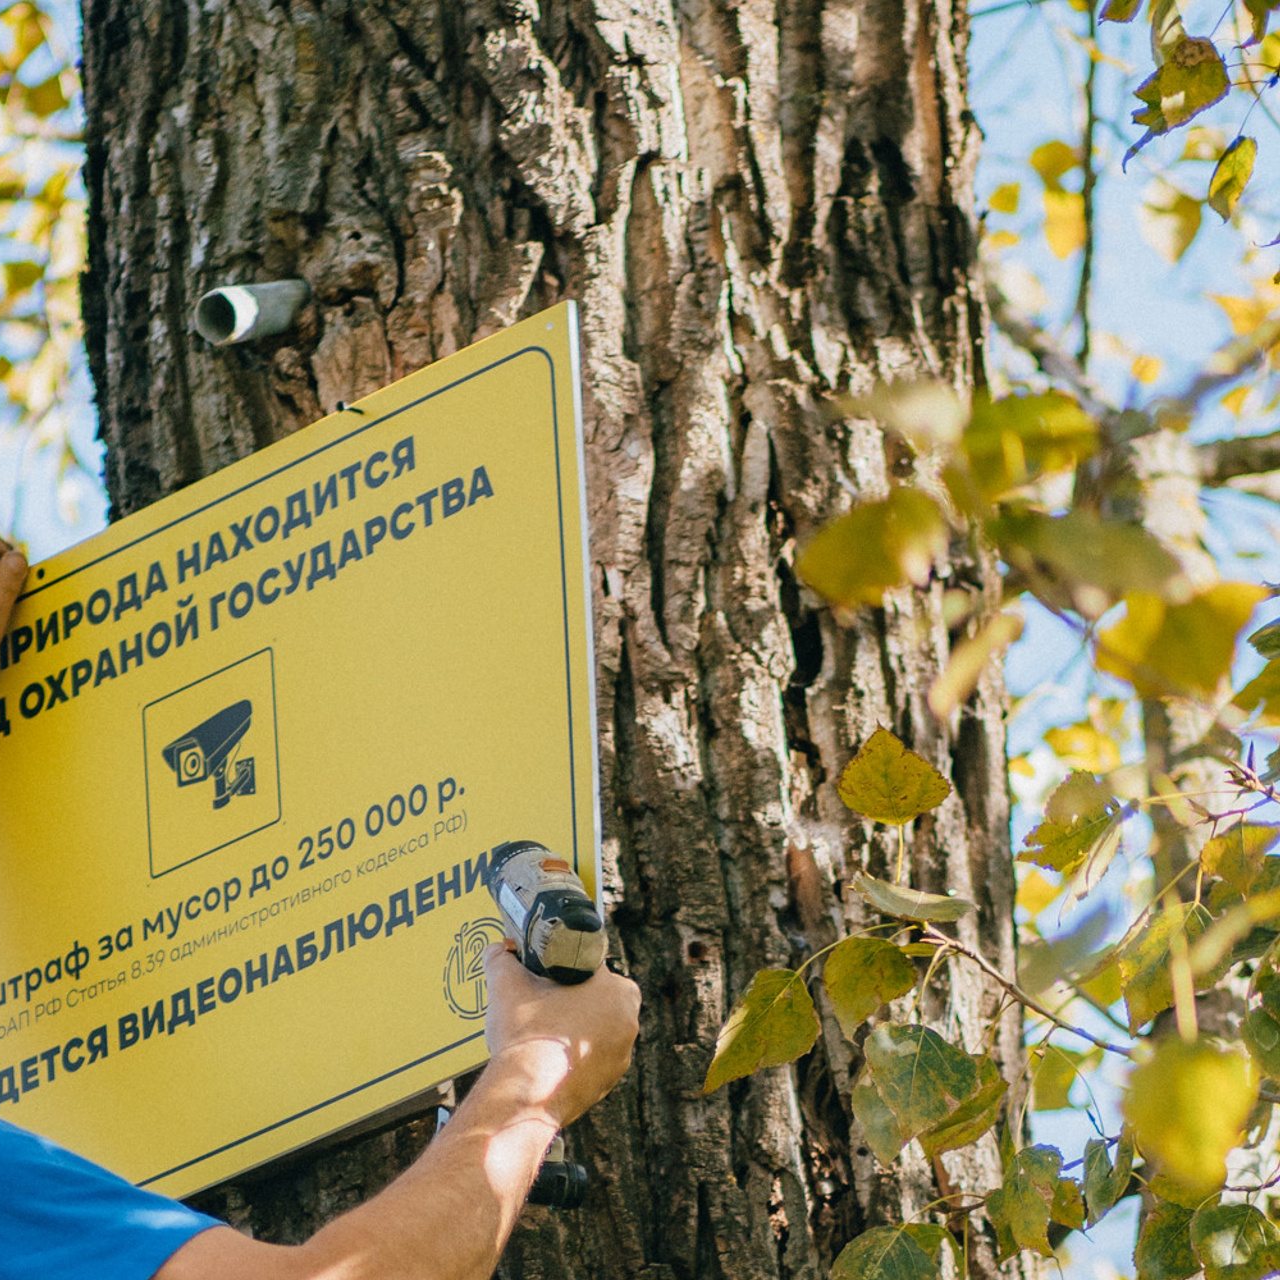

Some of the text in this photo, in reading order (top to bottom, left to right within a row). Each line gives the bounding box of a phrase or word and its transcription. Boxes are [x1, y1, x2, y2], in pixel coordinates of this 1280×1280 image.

[19, 593, 199, 719] ОХРАНОЙ
[210, 465, 494, 631] ГОСУДАРСТВА
[177, 435, 415, 584] НАХОДИТСЯ
[35, 1000, 62, 1024] РФ
[66, 970, 126, 1008] Статья
[130, 949, 165, 979] 8.39
[170, 868, 352, 962] административного
[356, 833, 429, 877] кодекса
[434, 808, 468, 842] РФ)
[98, 925, 133, 961] за
[142, 877, 242, 940] мусор
[249, 855, 289, 899] до
[297, 817, 356, 871] 250
[365, 783, 428, 837] 000
[437, 777, 466, 814] р.
[118, 840, 511, 1050] ВИДЕОНАБЛЮДЕНИ
